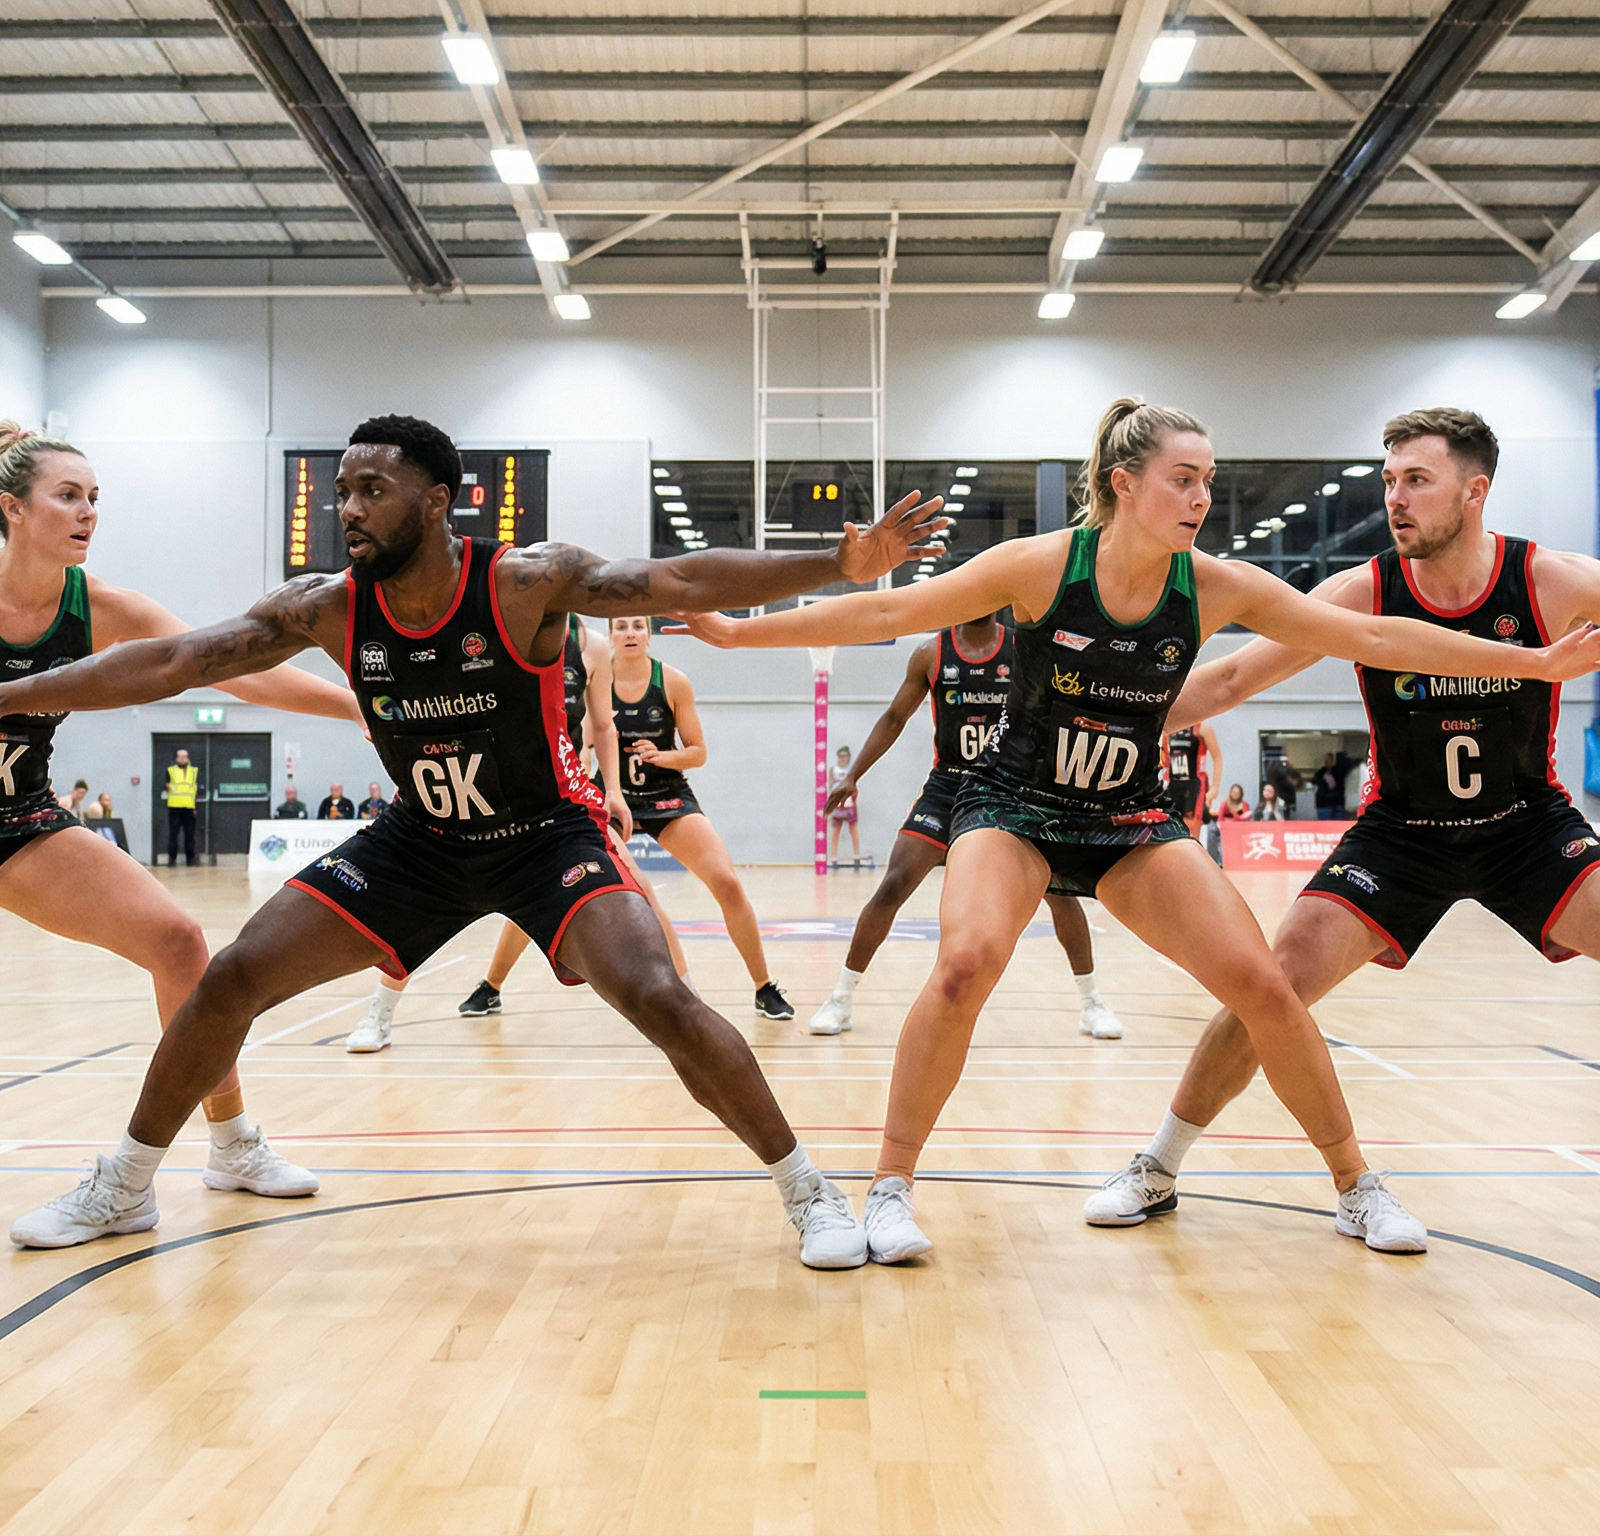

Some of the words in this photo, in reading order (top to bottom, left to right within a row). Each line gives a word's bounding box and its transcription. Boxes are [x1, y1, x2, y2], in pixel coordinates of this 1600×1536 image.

[412, 753, 496, 820] GK
[628, 754, 646, 787] C
[1054, 726, 1139, 791] WD
[1445, 735, 1482, 799] C
